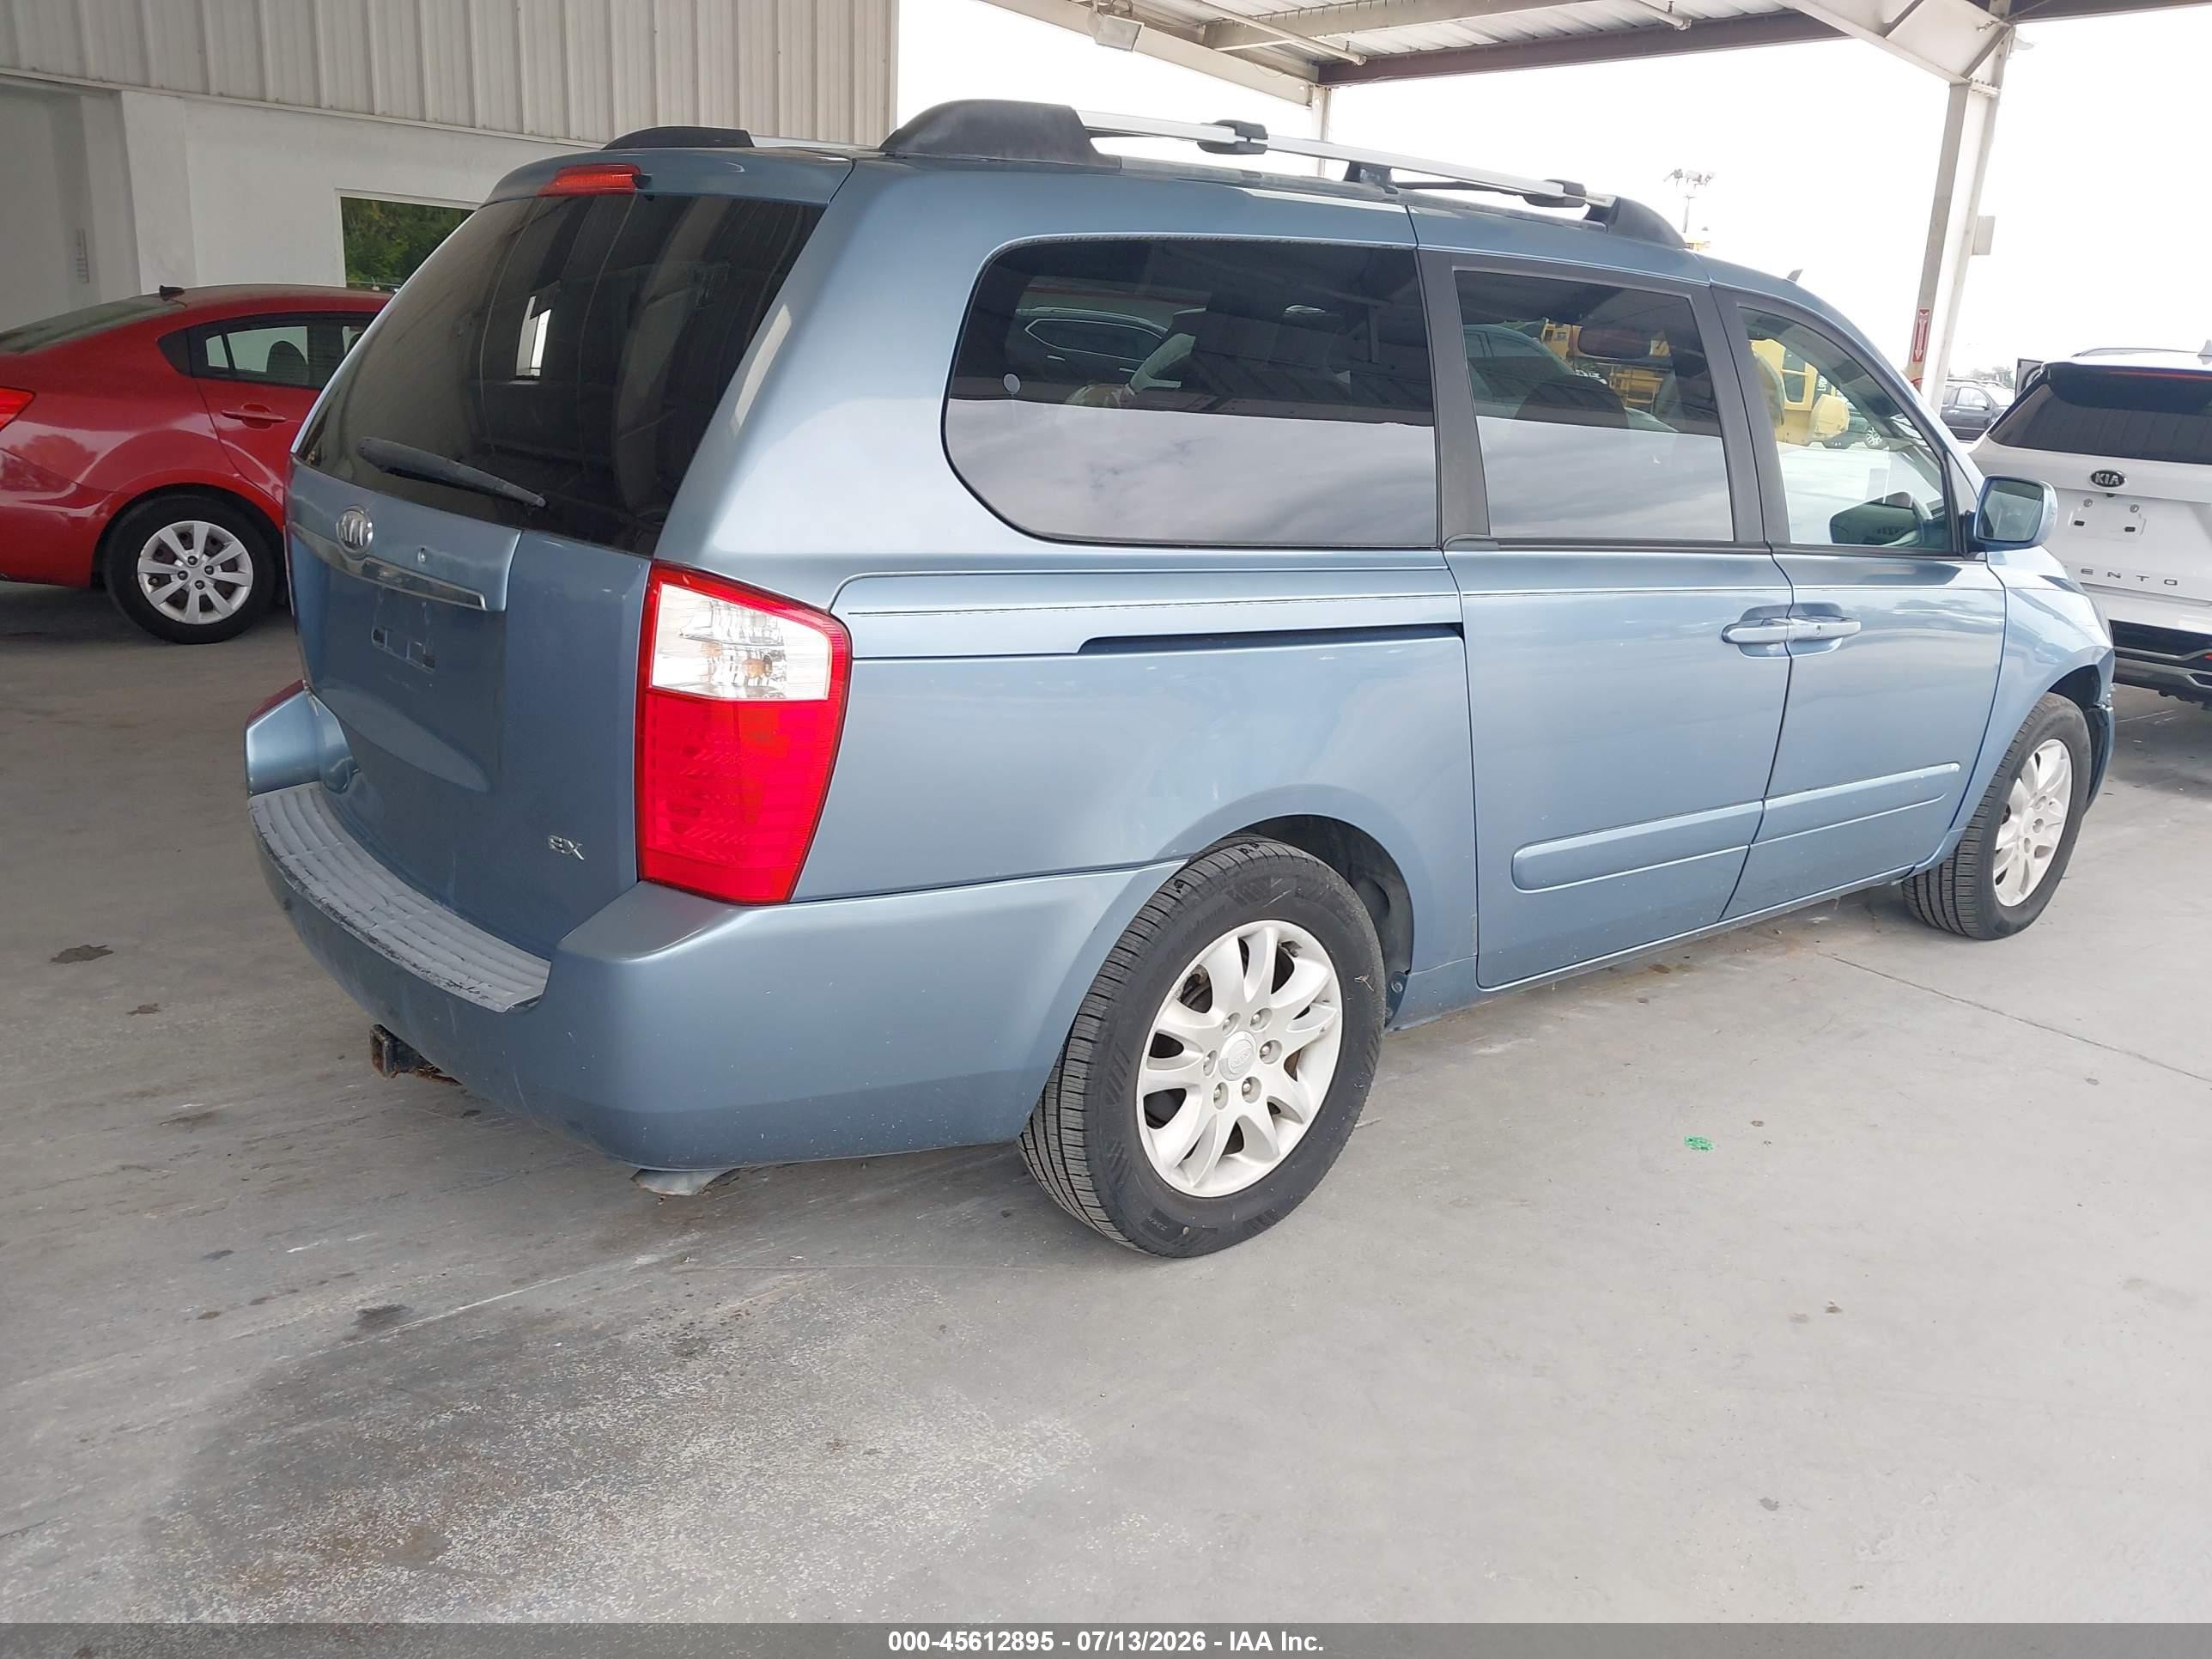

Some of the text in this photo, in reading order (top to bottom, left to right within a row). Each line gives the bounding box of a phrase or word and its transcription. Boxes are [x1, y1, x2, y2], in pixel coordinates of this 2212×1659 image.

[2094, 472, 2120, 486] KIA
[2064, 565, 2179, 586] ENTO
[548, 835, 585, 860] EX
